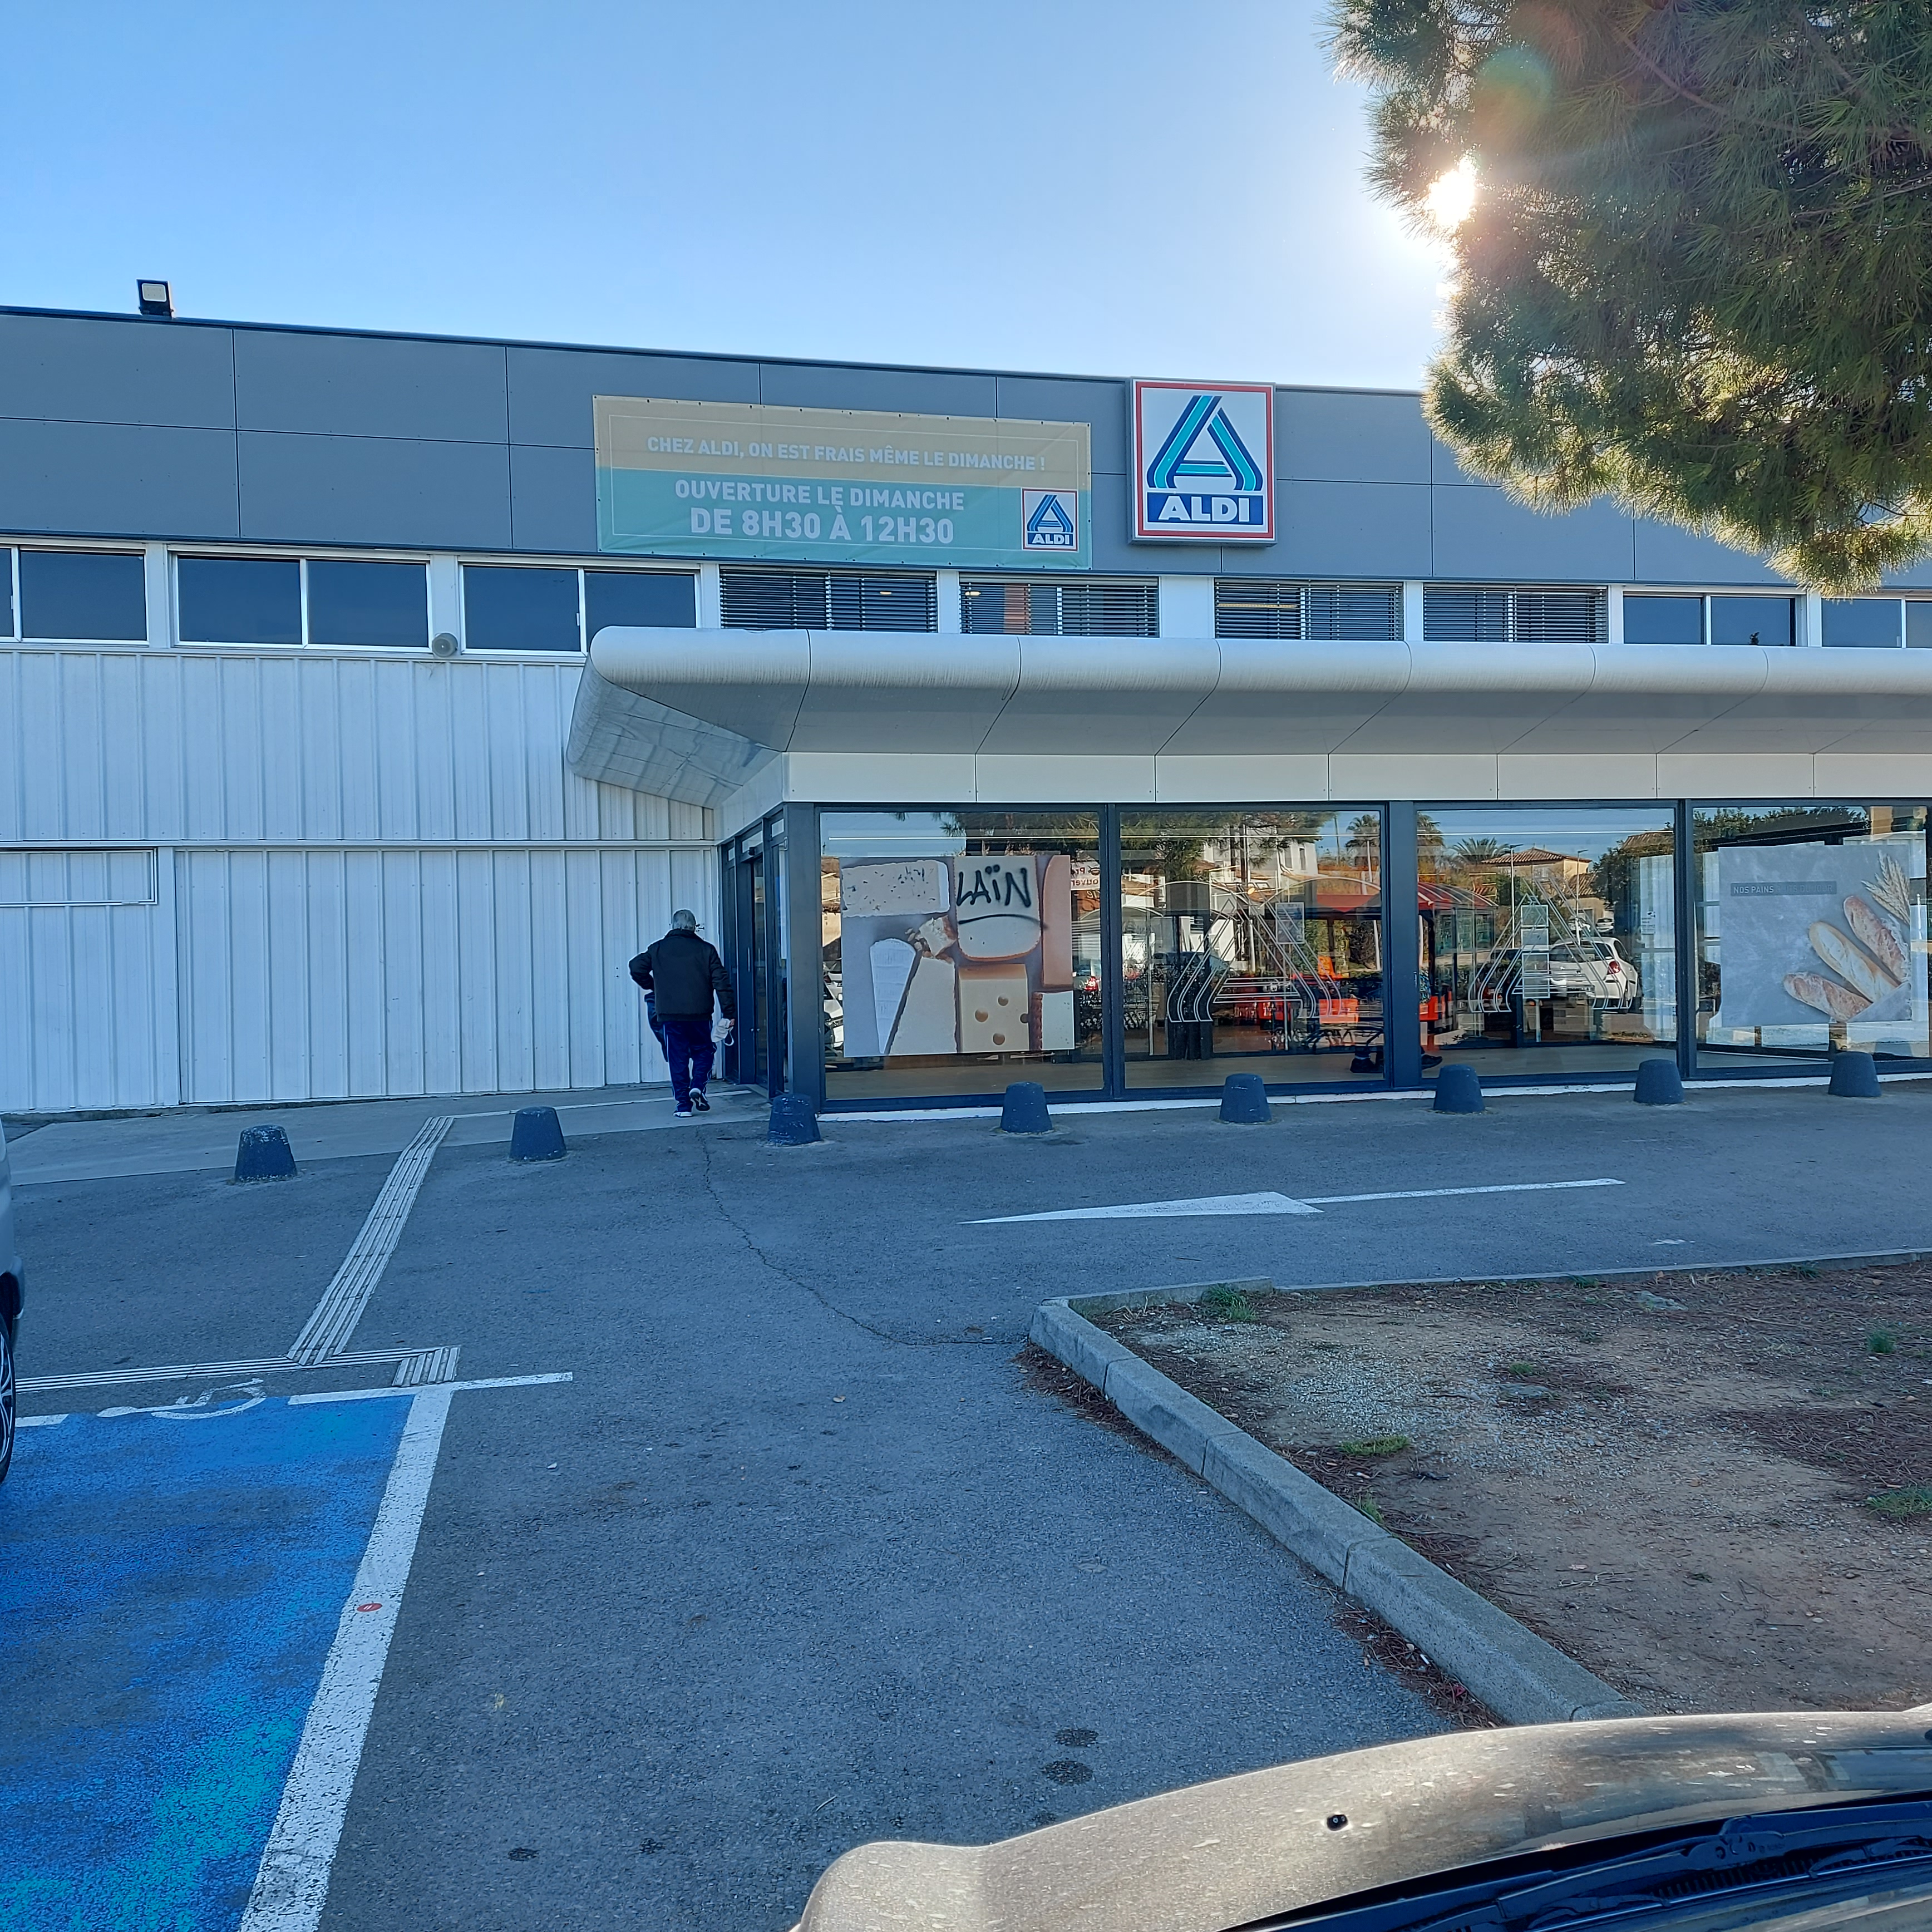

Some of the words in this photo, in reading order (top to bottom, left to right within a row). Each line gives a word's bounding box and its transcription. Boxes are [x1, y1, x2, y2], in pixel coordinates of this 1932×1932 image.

[647, 436, 694, 454] CHEZ
[698, 440, 745, 459] ALDI,
[748, 442, 773, 458] ON
[778, 443, 810, 460] EST
[815, 445, 865, 462] FRAIS
[870, 445, 919, 465] MÊME
[924, 451, 944, 466] LE
[949, 452, 1036, 471] DIMANCHE
[675, 480, 811, 504] OUVERTURE
[817, 486, 843, 505] LE
[850, 488, 964, 511] DIMANCHE
[1158, 495, 1250, 523] ALDI
[691, 507, 732, 534] DE
[742, 510, 821, 539] 8H30
[829, 506, 851, 540] À
[861, 515, 954, 544] 12H30
[1032, 534, 1070, 545] ALDI
